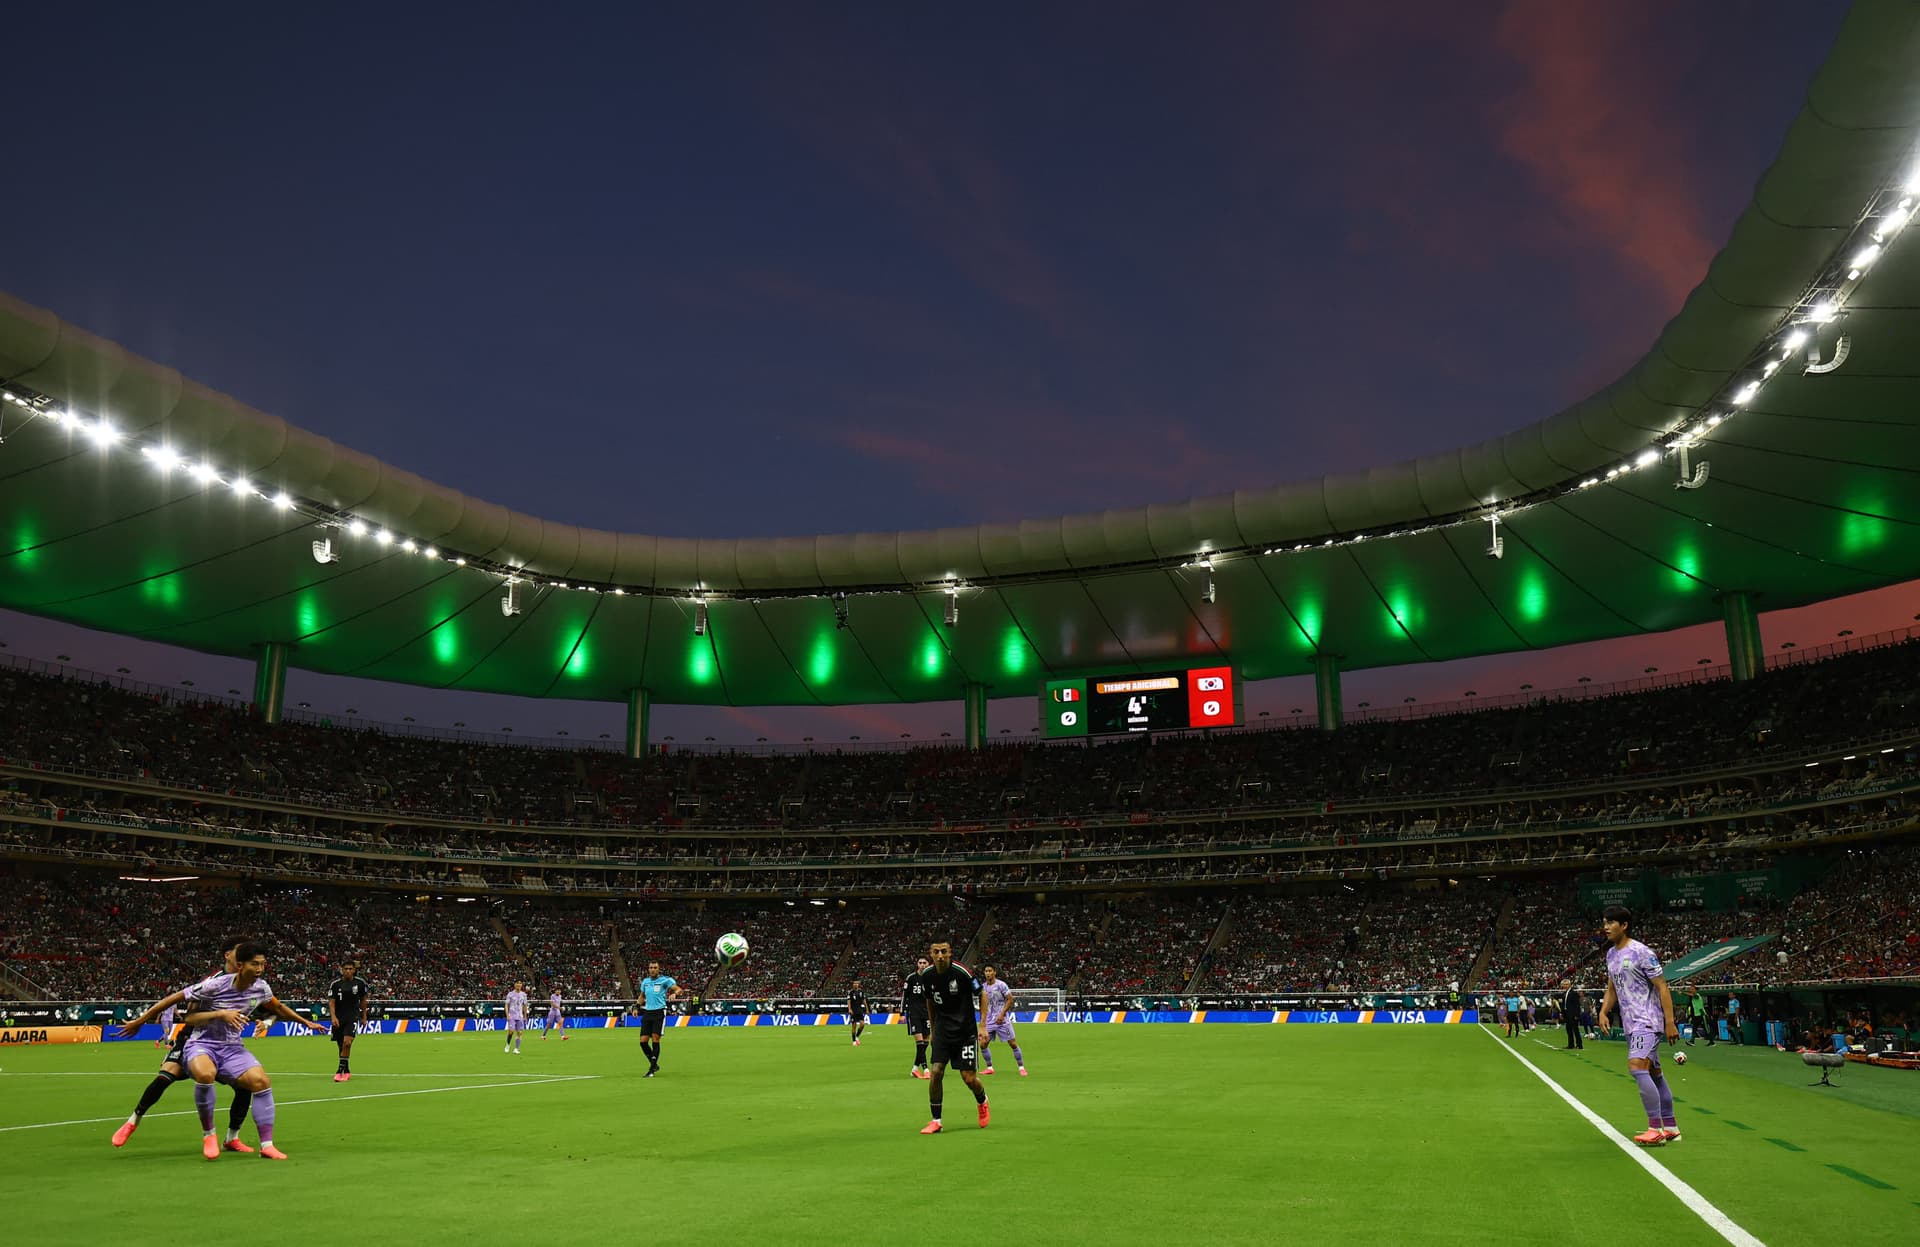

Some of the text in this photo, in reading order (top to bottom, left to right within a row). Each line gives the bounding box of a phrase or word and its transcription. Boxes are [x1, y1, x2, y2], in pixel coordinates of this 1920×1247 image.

[1104, 683, 1131, 693] TIEMPO
[1128, 696, 1146, 714] 4'
[1816, 785, 1886, 801] GUADALAJARA
[80, 816, 149, 830] GUADALAJARA
[444, 853, 502, 861] GUADALAJARA
[703, 1016, 730, 1027] VISA
[770, 1015, 800, 1026] VISA
[840, 1014, 871, 1025] VA
[1305, 1011, 1339, 1023] VISA
[1389, 1012, 1426, 1023] VISA
[418, 1018, 442, 1032] VISA
[473, 1018, 495, 1031] VISA
[1, 1030, 48, 1043] AJARA
[961, 1044, 975, 1060] 25
